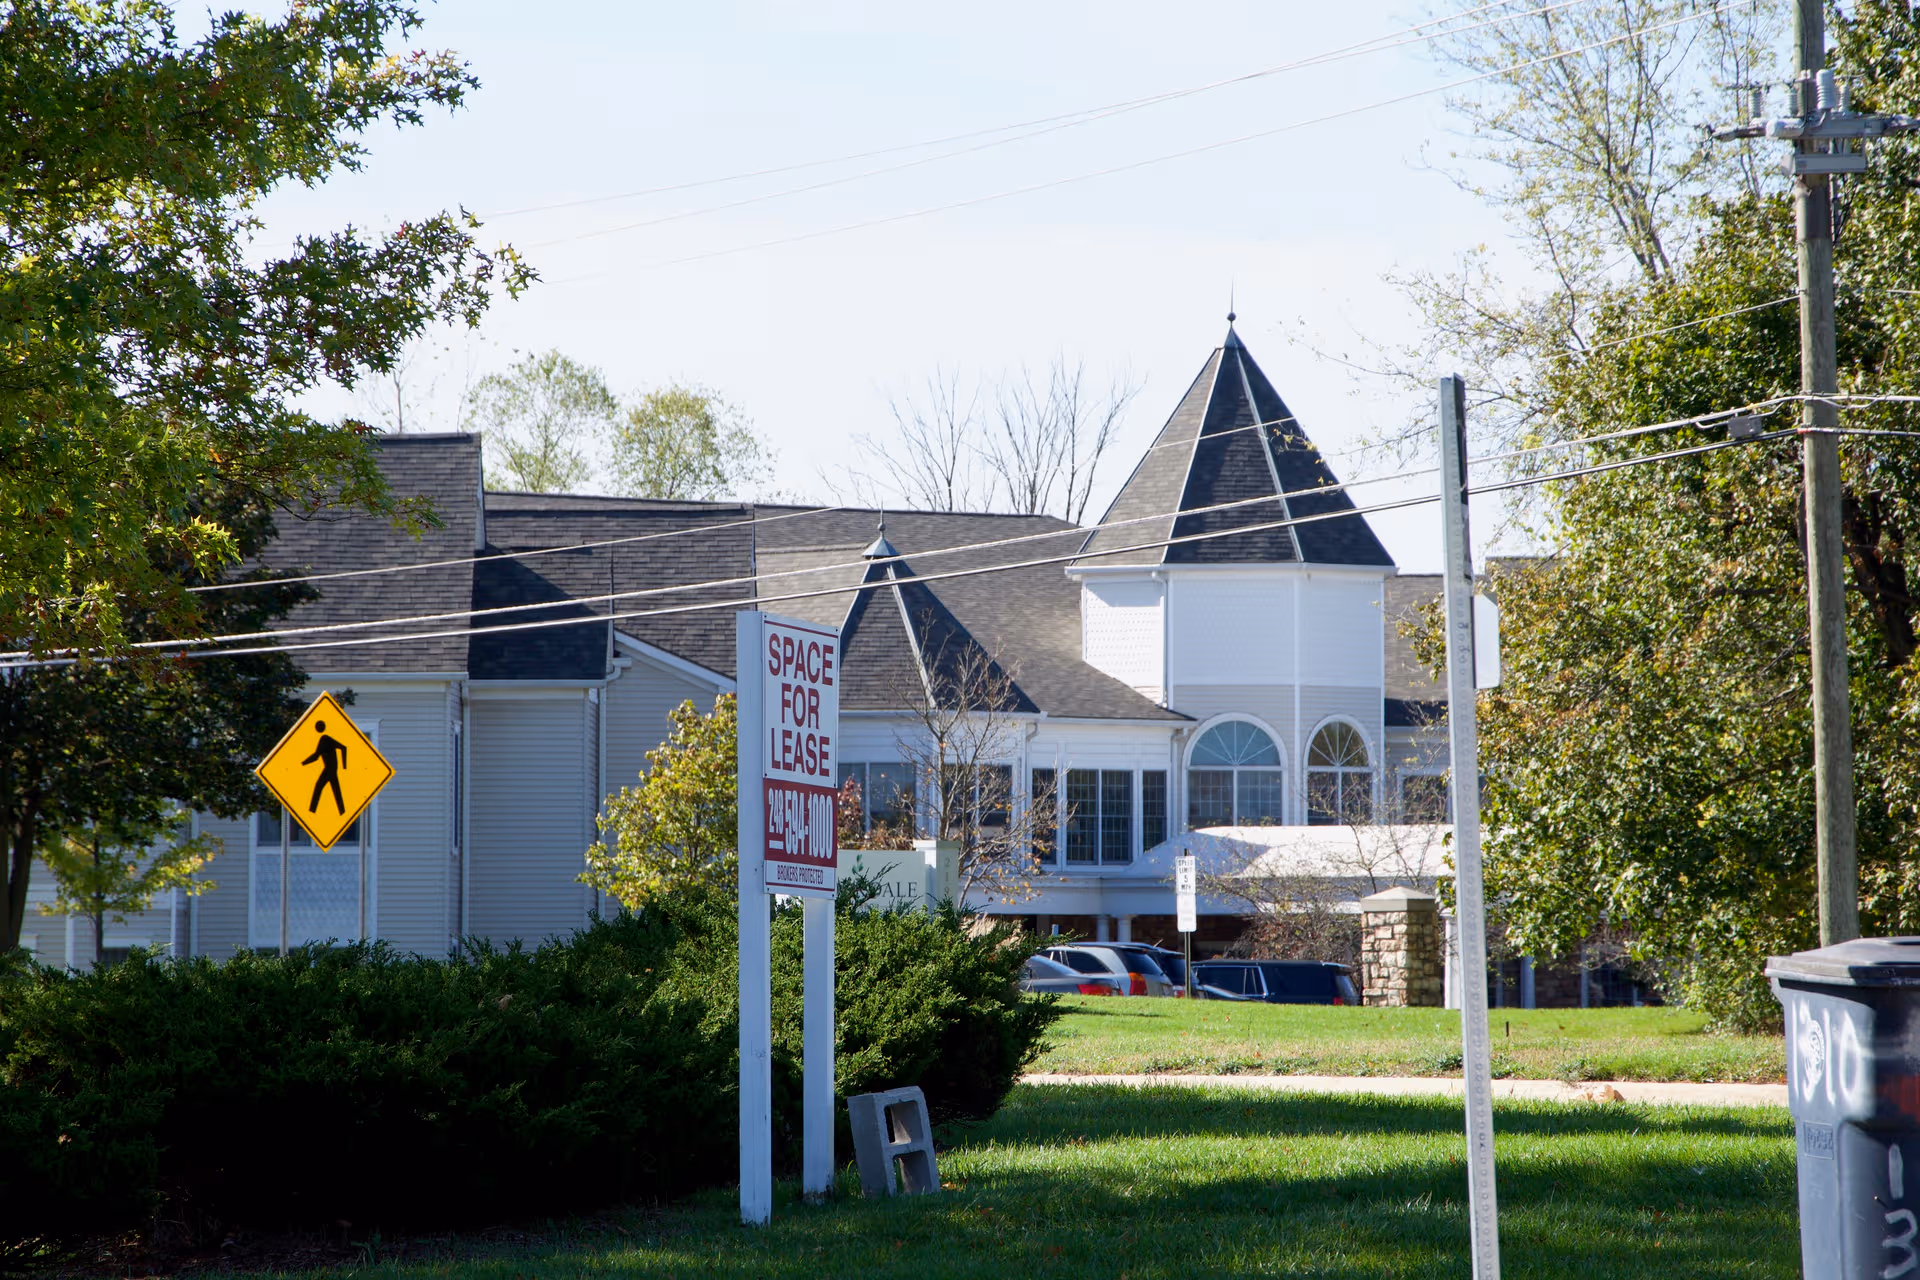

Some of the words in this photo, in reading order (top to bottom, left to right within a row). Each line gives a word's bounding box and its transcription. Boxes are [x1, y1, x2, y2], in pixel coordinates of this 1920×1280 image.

[768, 632, 834, 686] SPACE
[781, 682, 820, 730] FOR
[771, 727, 830, 777] LEASE
[768, 787, 784, 835] 248
[777, 864, 798, 882] BROKERS
[799, 866, 824, 885] PROTECTED
